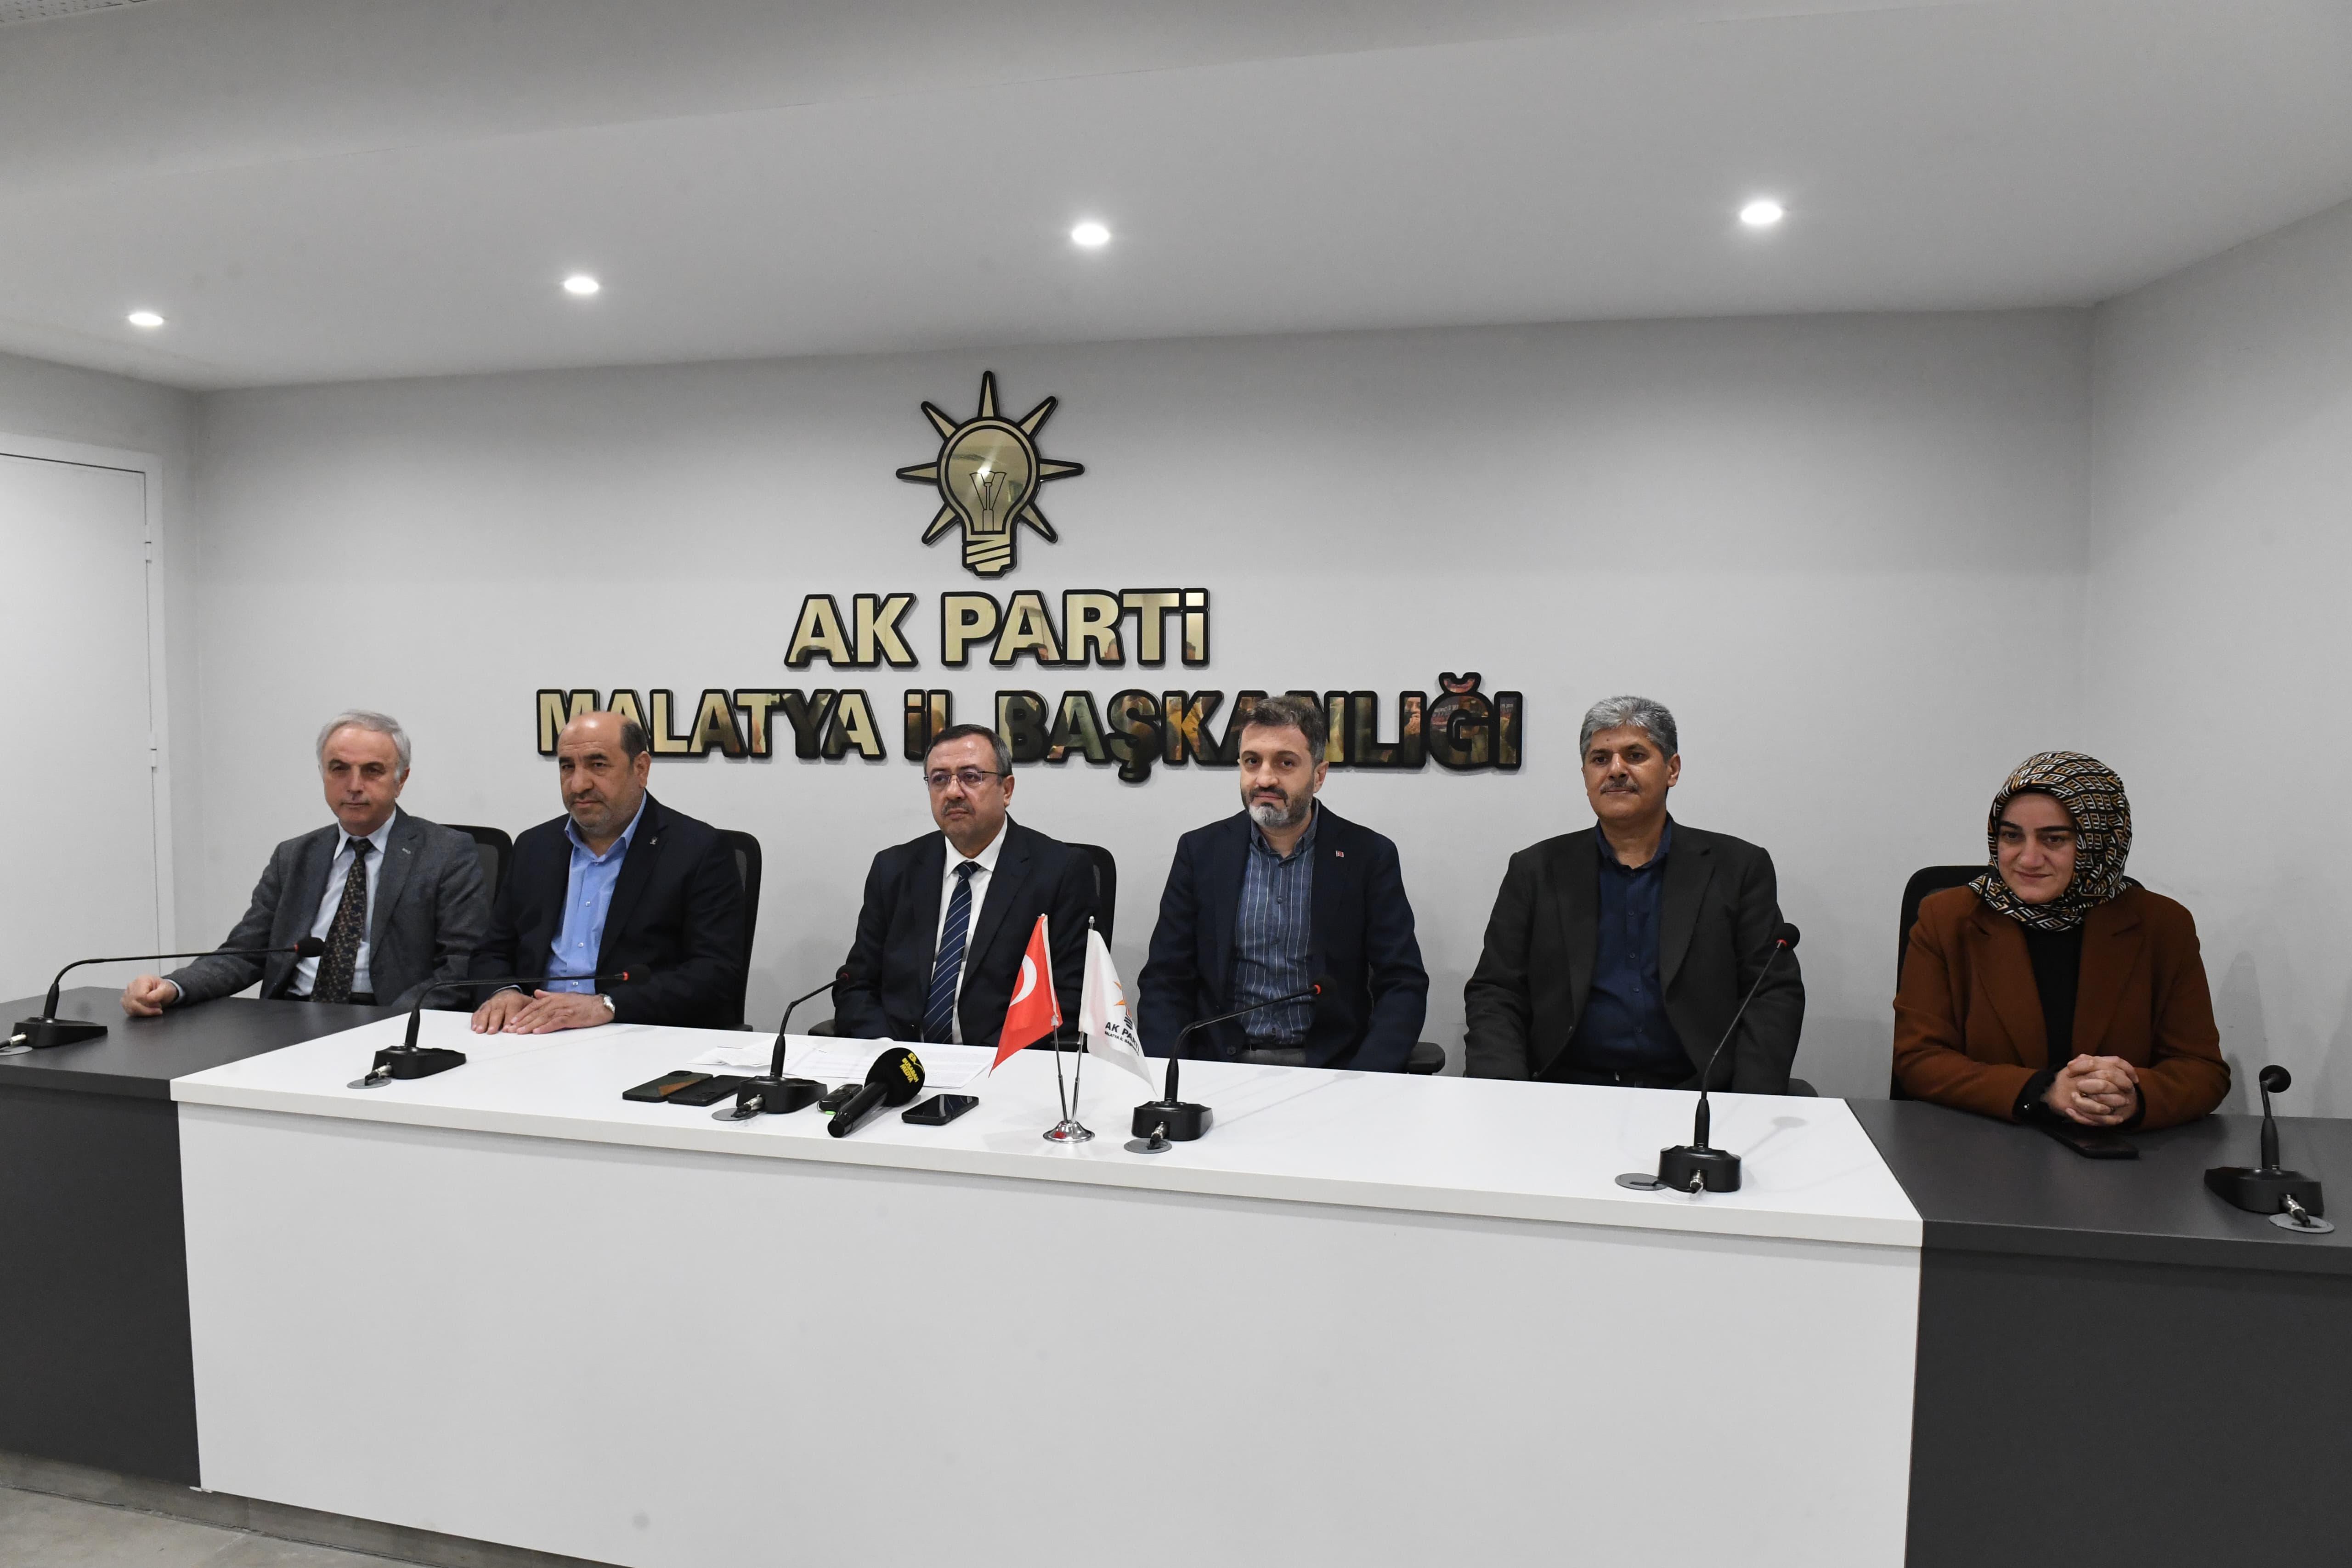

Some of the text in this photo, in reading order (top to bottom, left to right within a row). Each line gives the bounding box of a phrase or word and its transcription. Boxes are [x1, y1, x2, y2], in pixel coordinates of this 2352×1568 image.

[784, 593, 919, 667] AK
[1105, 1022, 1120, 1032] AK
[899, 1064, 913, 1083] MEDYA
